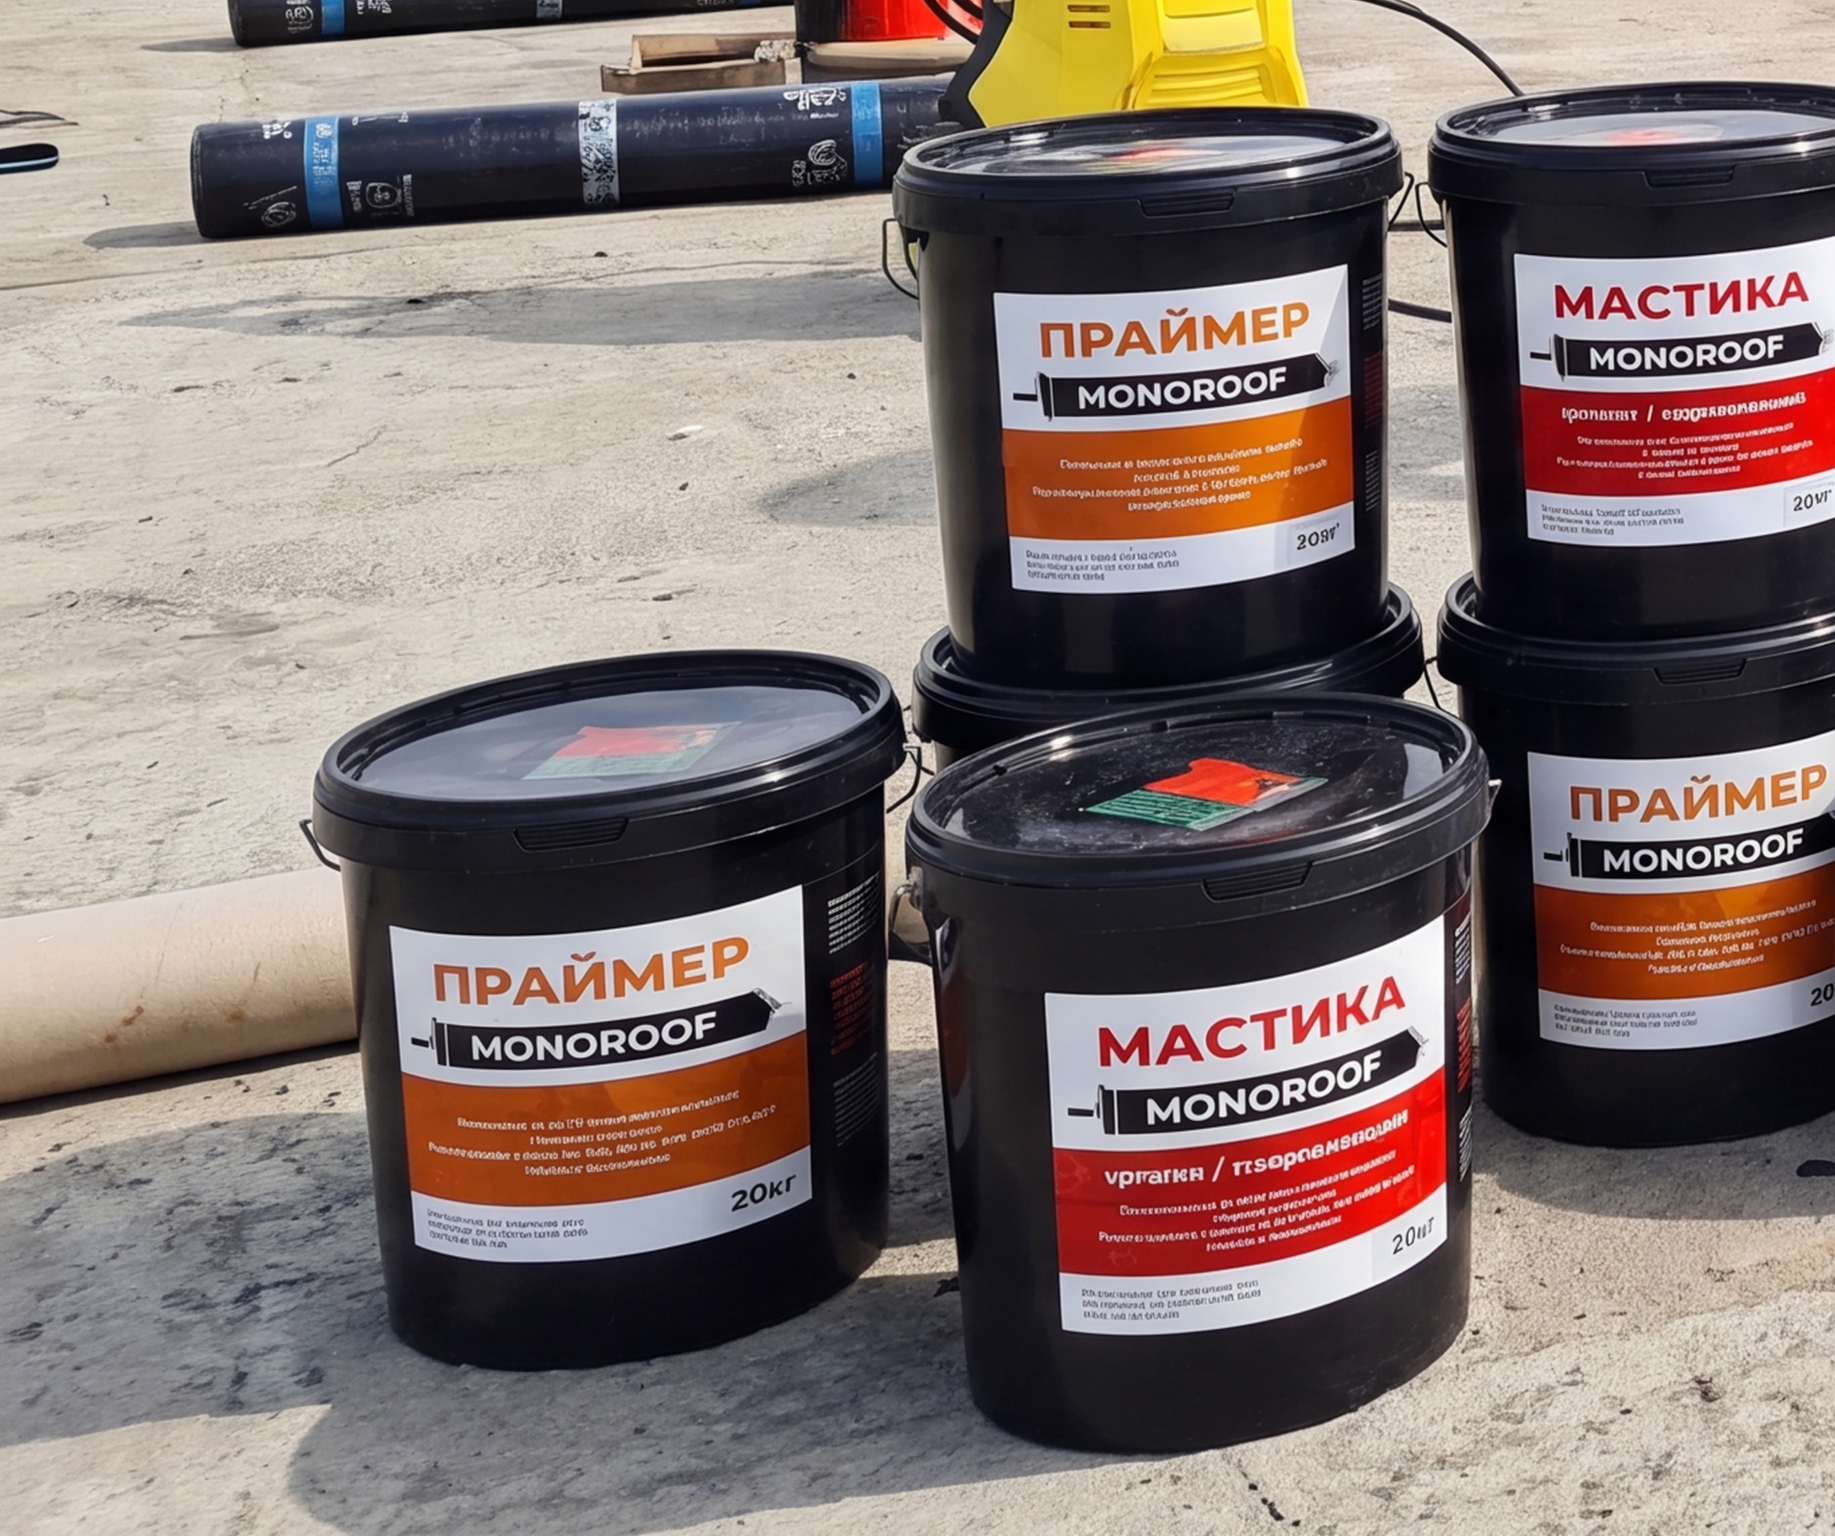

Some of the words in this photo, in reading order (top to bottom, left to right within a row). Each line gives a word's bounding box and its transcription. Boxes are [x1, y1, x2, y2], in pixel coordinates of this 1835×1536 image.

[1554, 271, 1809, 321] МАСТИКА
[1039, 302, 1310, 359] ПРАЙМЕР
[1589, 335, 1784, 371] MONOROOF
[1078, 366, 1287, 410] MONOROOF
[1570, 764, 1827, 823] ПРАЙМЕР
[1603, 828, 1803, 874] MONOROOF
[433, 937, 750, 1006] ПРАЙМЕР
[471, 1011, 717, 1061] MONOROOF
[1098, 976, 1406, 1067] МАСТИКА
[1146, 1050, 1382, 1126] MONOROOF
[731, 1174, 797, 1213] 20кг
